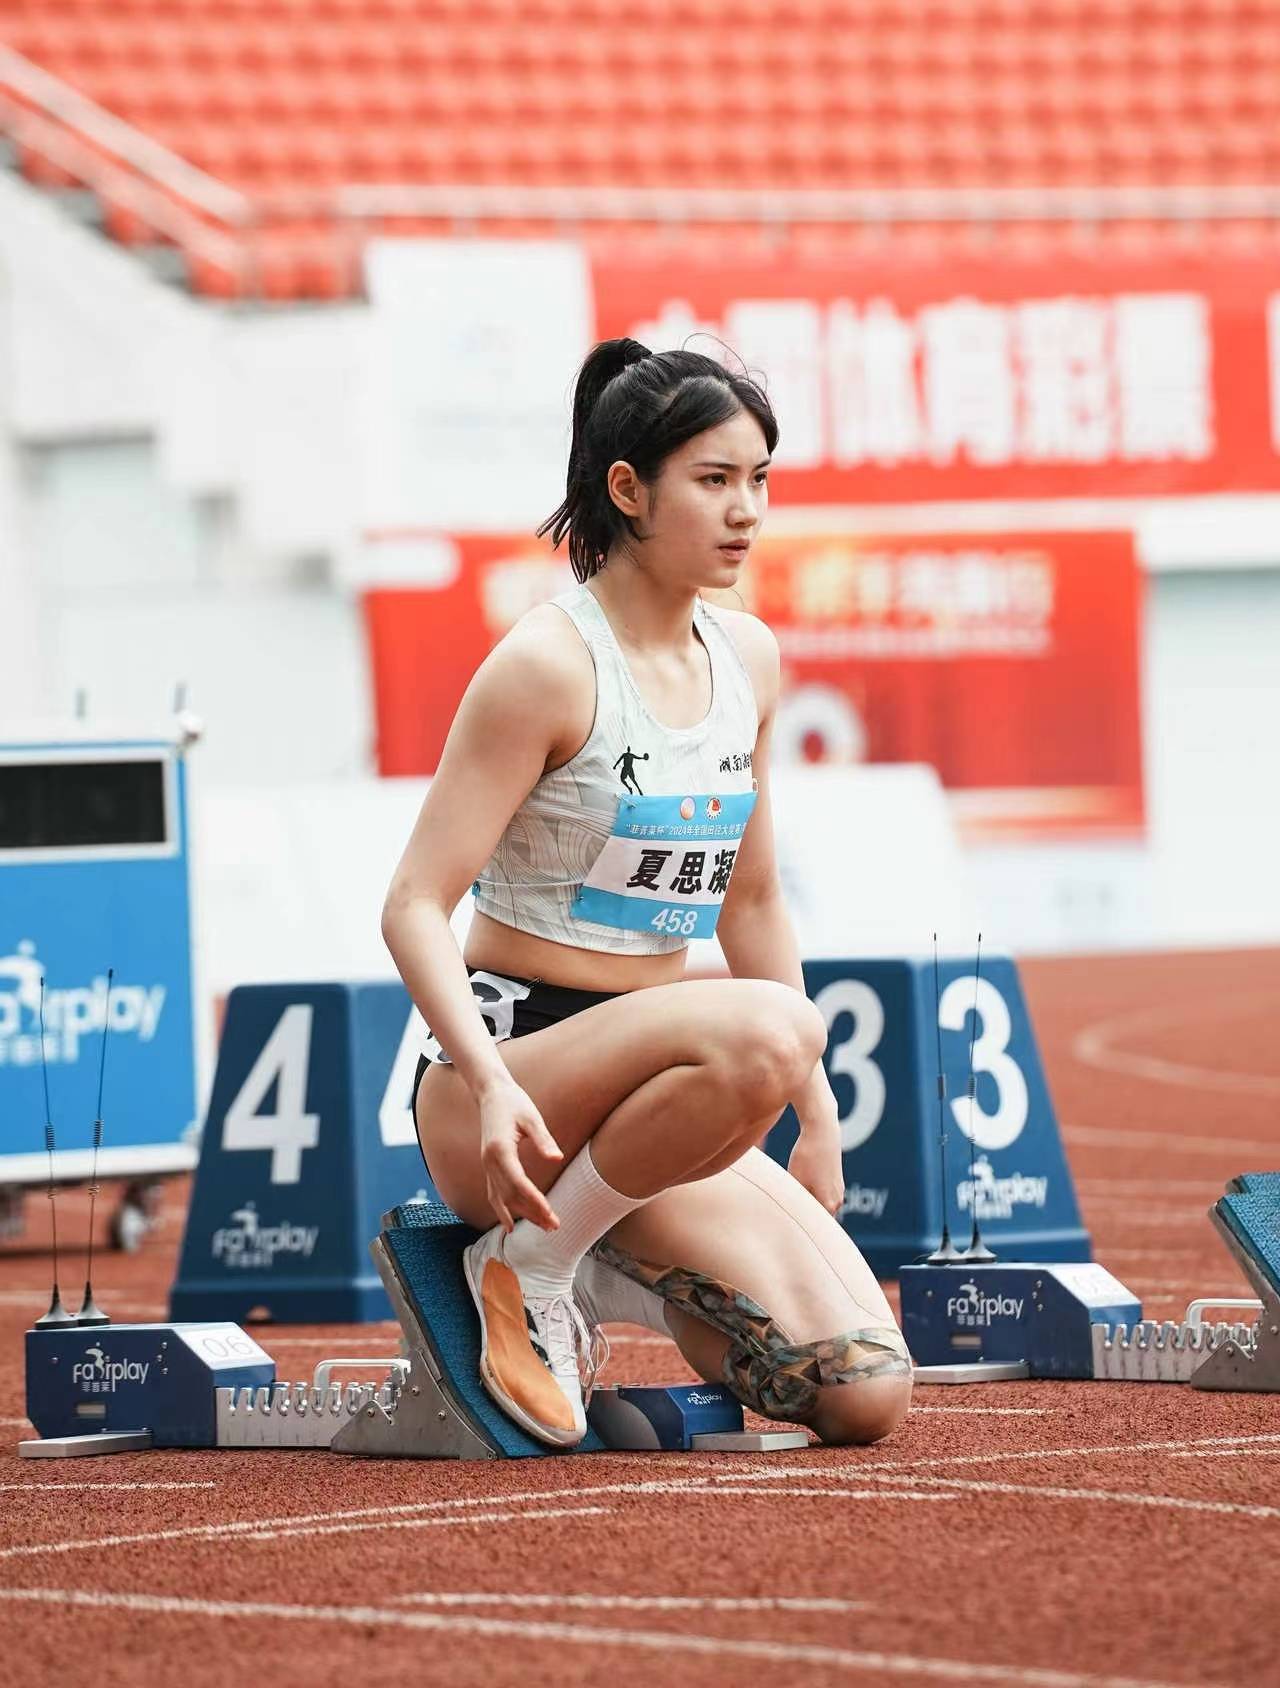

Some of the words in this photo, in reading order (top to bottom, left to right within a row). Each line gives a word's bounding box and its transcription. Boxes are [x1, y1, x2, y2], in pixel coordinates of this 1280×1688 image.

[650, 908, 698, 935] 458
[221, 1003, 320, 1184] 4
[815, 979, 887, 1151] 3
[938, 975, 1029, 1150] 3
